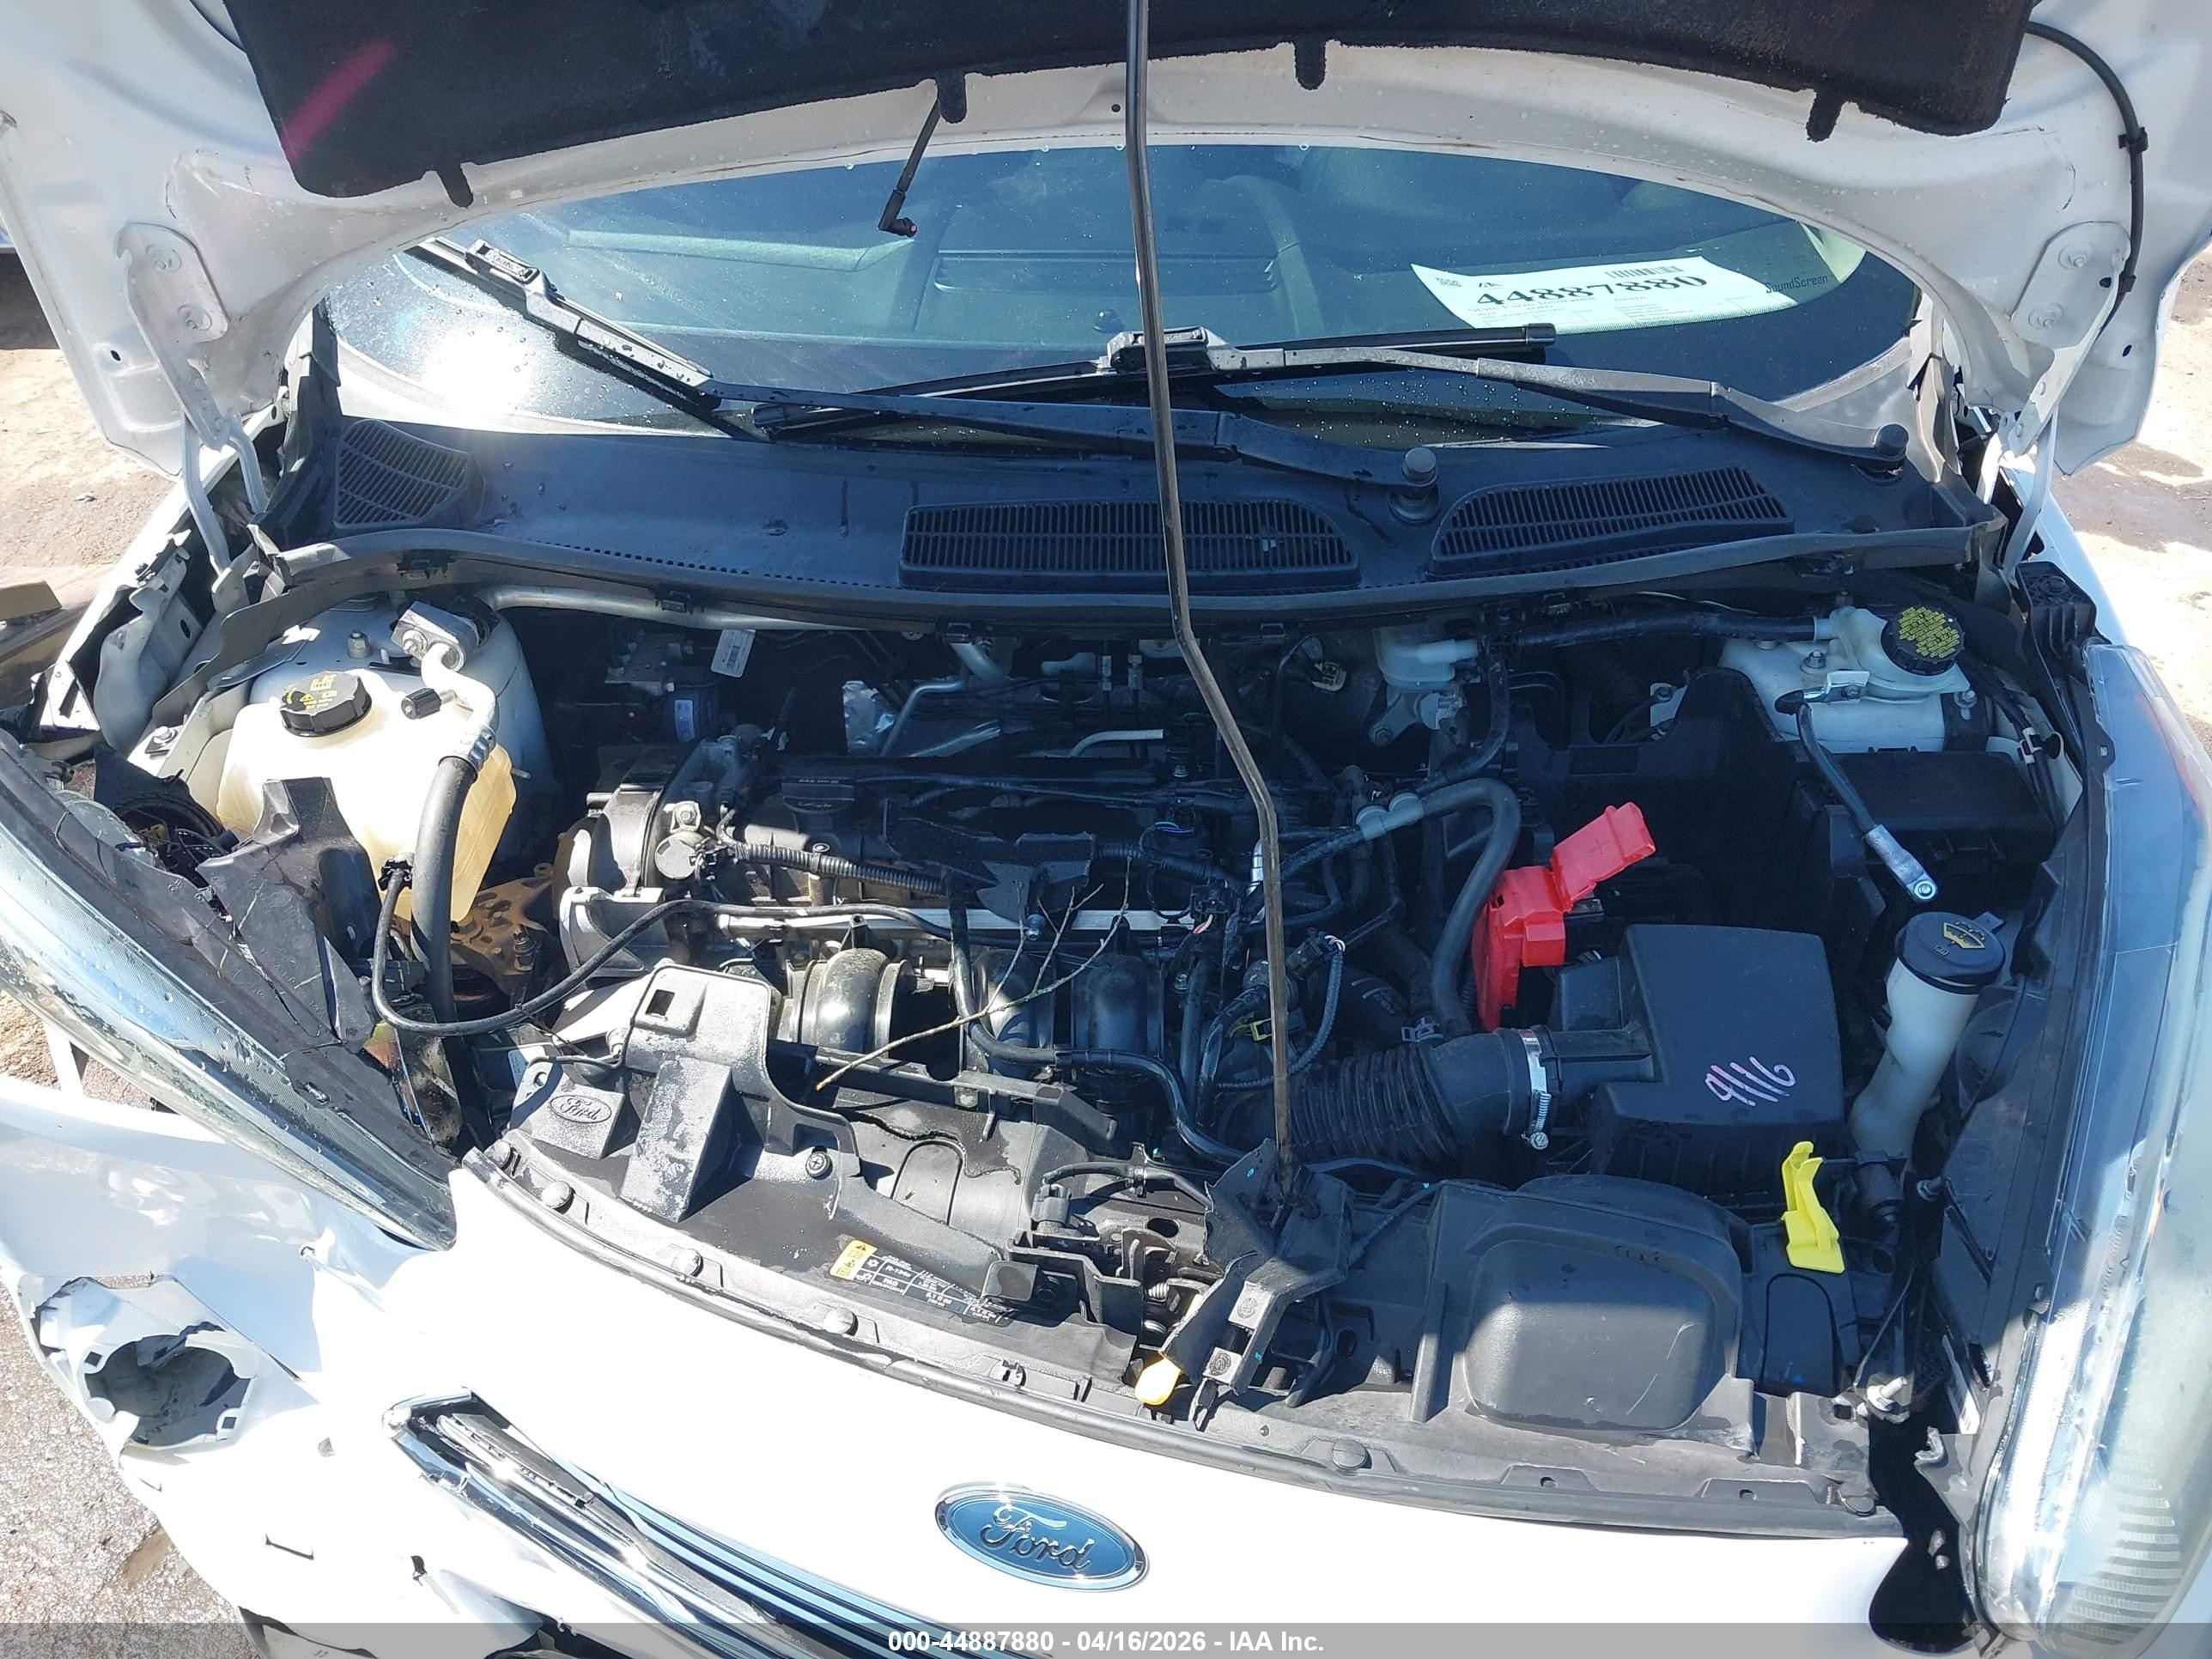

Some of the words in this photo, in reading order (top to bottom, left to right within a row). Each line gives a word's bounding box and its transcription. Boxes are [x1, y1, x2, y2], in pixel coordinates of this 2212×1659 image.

[1477, 276, 1708, 305] 44887880
[1765, 275, 1829, 295] SoundScreen
[980, 1504, 1096, 1570] Ford
